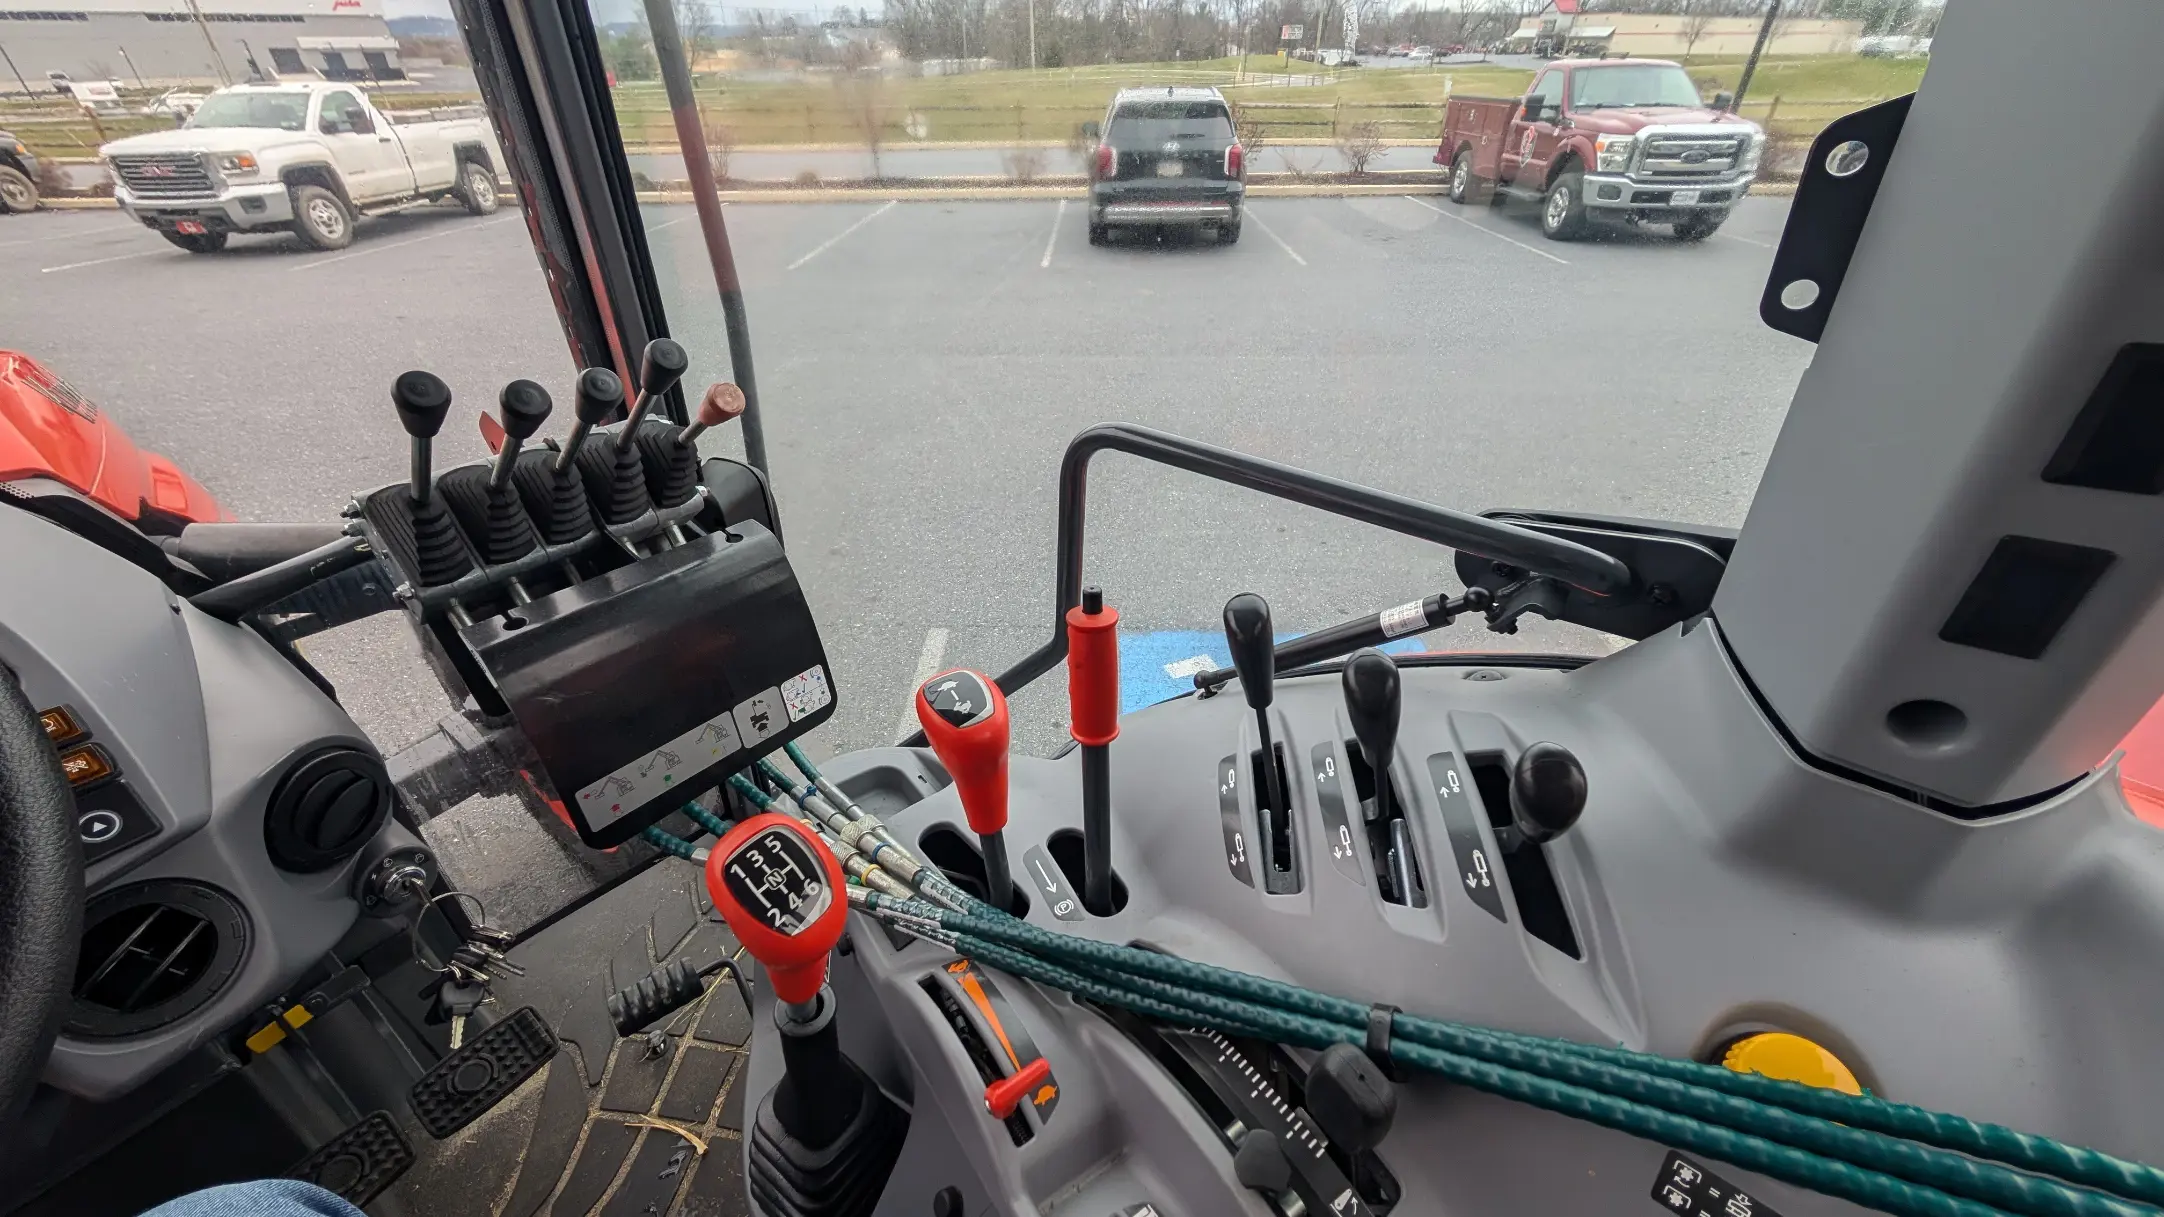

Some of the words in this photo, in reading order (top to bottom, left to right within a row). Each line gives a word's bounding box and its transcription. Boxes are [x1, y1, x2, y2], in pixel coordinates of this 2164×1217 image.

[730, 864, 746, 879] 1
[746, 849, 764, 868] 3
[763, 835, 782, 854] 5
[768, 872, 783, 886] N
[766, 907, 785, 928] 2
[788, 892, 803, 910] 4
[803, 878, 821, 896] 6
